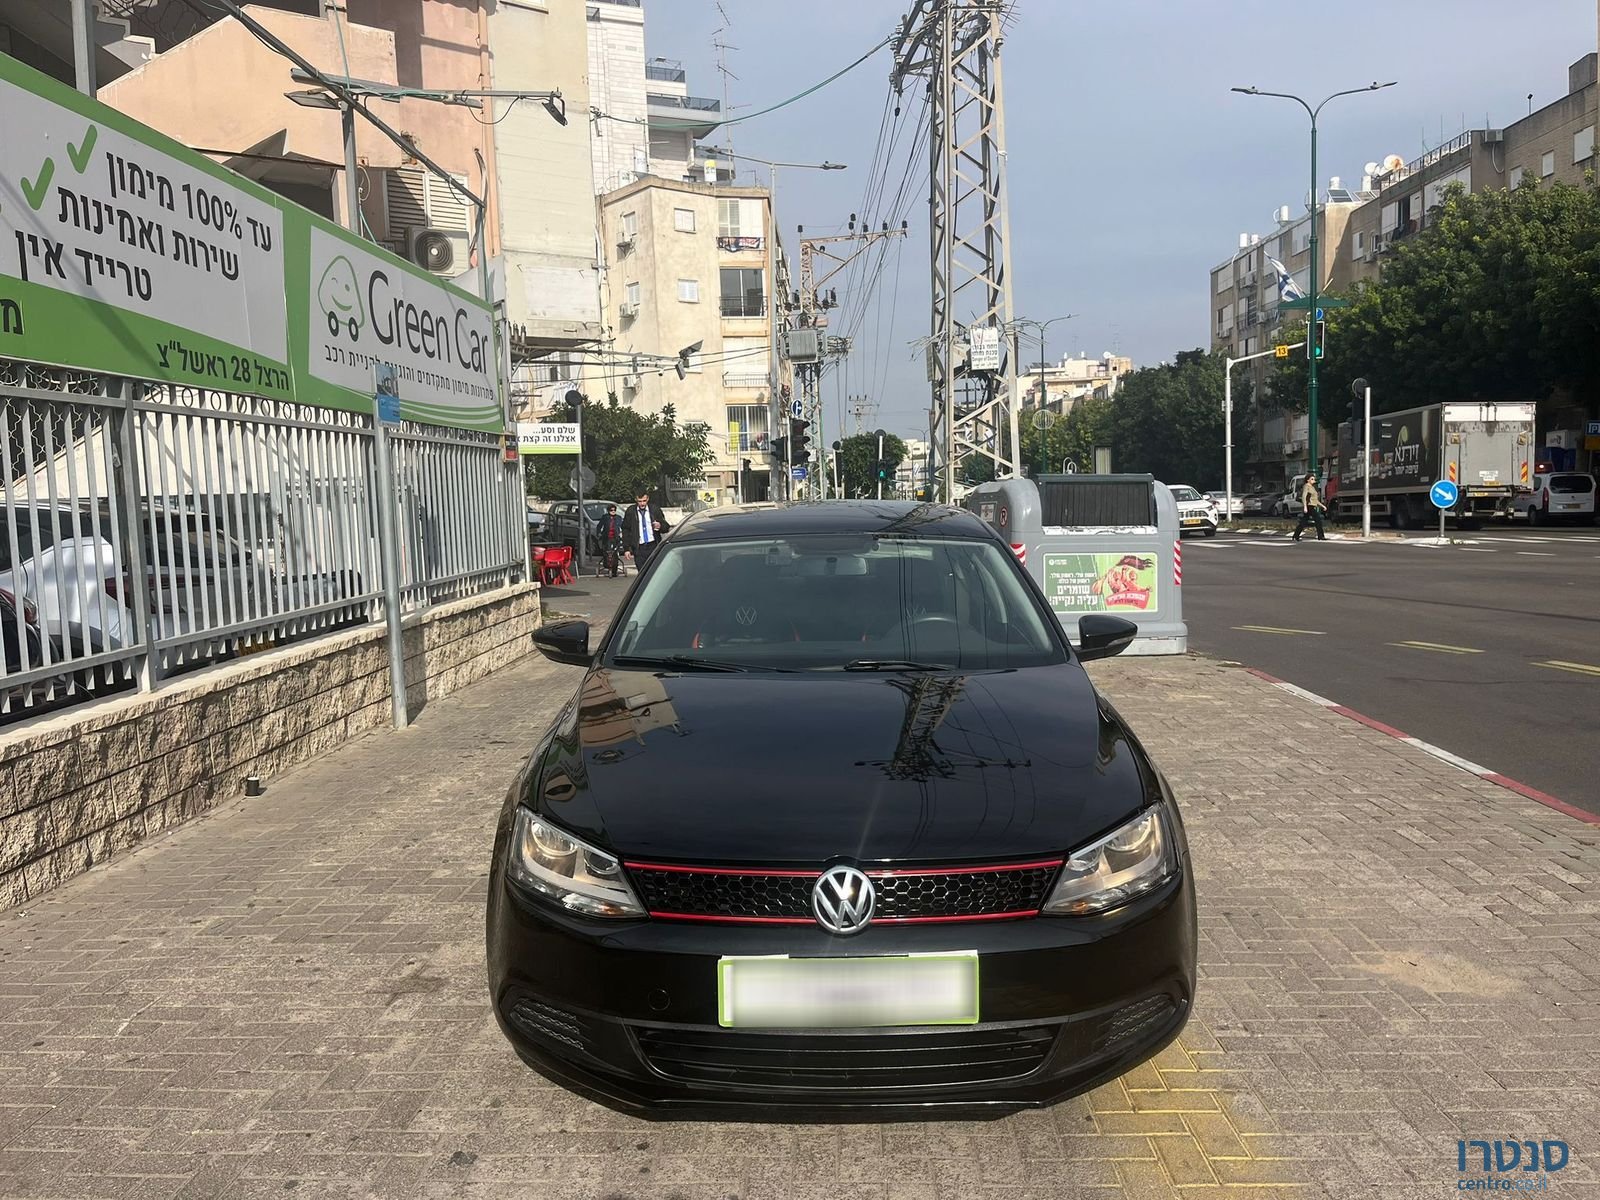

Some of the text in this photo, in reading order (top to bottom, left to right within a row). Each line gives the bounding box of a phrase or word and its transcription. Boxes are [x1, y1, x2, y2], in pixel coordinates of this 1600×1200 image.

[106, 152, 272, 253] עד 100% מימון
[57, 186, 239, 281] שירות ואמינות
[15, 230, 152, 301] טרייד אין
[369, 270, 489, 375] Green Car
[324, 344, 346, 364] רכב
[1279, 347, 1287, 355] 13
[231, 356, 250, 384] 28
[255, 358, 290, 391] הרצל
[417, 369, 450, 392] מתקדמים
[452, 378, 469, 396] מימון
[471, 383, 494, 401] פתרונות
[542, 435, 552, 443] זה
[553, 435, 576, 443] אצלנו
[557, 426, 576, 434] שלם
[522, 435, 540, 444] קצת
[1057, 585, 1090, 595] שומרים
[1049, 595, 1075, 607] נקייה!
